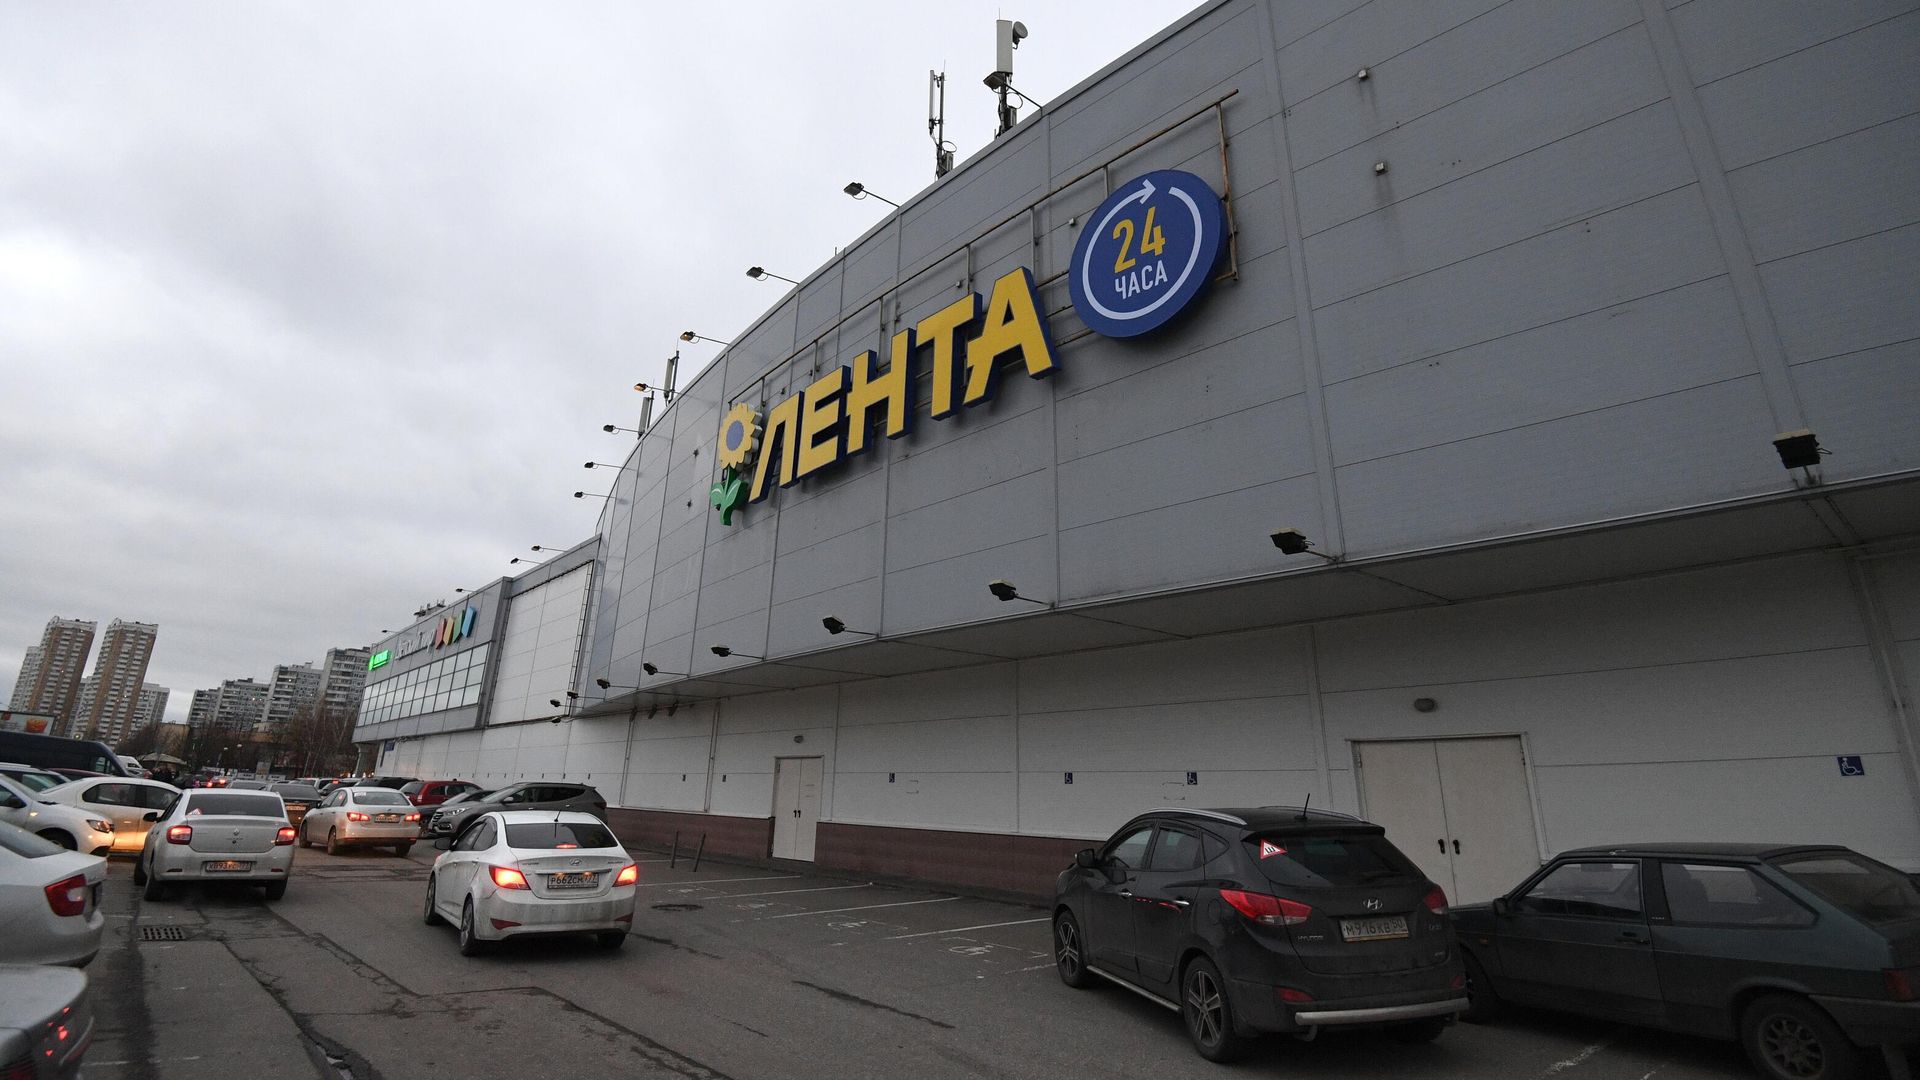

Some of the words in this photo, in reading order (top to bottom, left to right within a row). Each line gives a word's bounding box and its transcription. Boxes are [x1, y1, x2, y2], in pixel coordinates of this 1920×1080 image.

[1112, 206, 1166, 272] 24
[1114, 259, 1168, 301] ЧАСА
[749, 266, 1060, 504] ЛЕНТА
